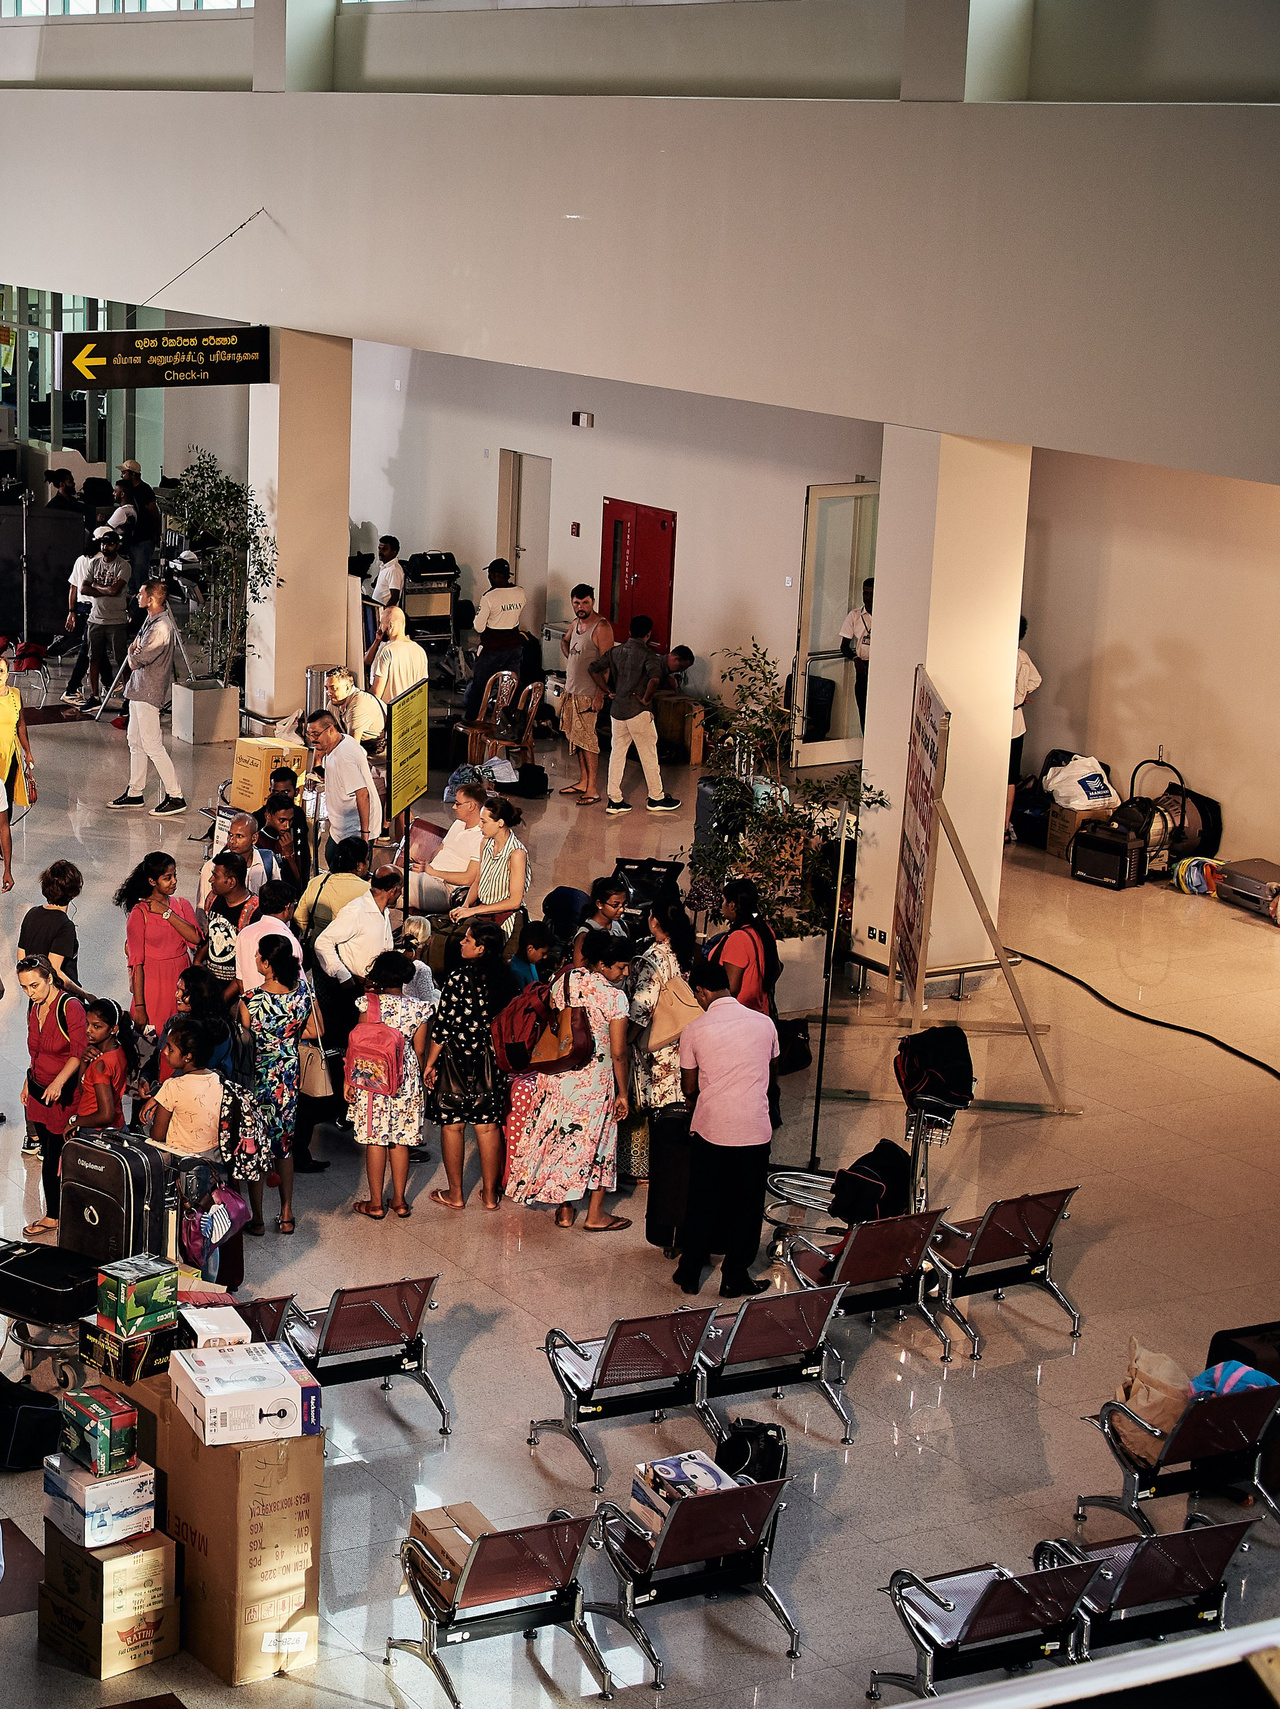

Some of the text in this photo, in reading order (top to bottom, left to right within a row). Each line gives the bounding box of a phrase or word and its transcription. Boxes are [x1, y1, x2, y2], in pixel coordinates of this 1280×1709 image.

[112, 353, 142, 365] விமான
[164, 369, 209, 382] Check-in
[157, 1312, 174, 1323] Lucas
[90, 1403, 107, 1416] Lucas
[98, 1453, 106, 1476] Lucas
[249, 1522, 264, 1535] KGS
[174, 1515, 208, 1557] MADE
[249, 1538, 263, 1552] KGS
[275, 1549, 285, 1561] 48
[248, 1555, 262, 1569] PCS
[294, 1559, 309, 1571] ITEM
[260, 1568, 277, 1582] 3226
[126, 1629, 154, 1646] RATTHI
